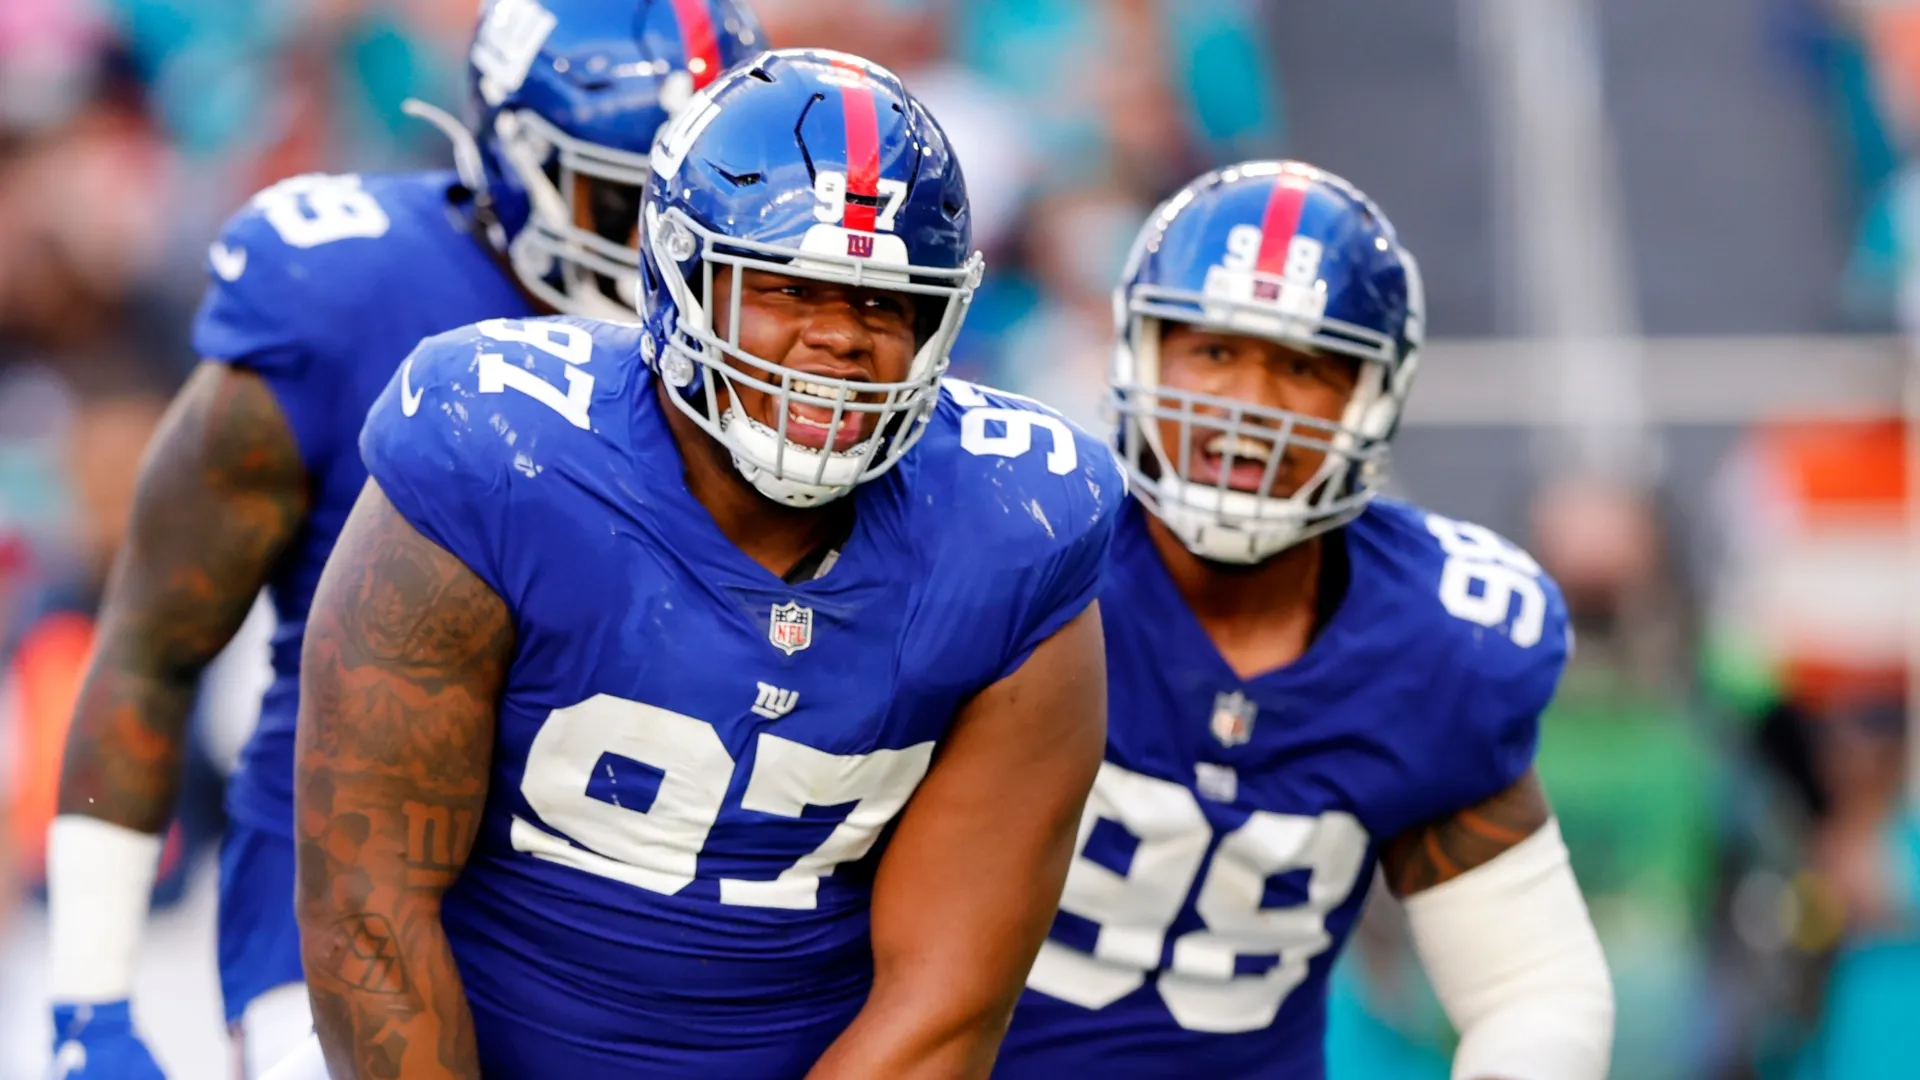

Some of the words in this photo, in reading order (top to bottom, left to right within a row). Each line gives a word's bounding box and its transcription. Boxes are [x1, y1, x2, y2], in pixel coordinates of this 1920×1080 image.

[813, 171, 907, 231] 97
[1223, 224, 1323, 283] 98
[476, 318, 595, 430] 97
[776, 624, 805, 643] NFL
[510, 692, 936, 909] 97
[1025, 760, 1371, 1033] 98
